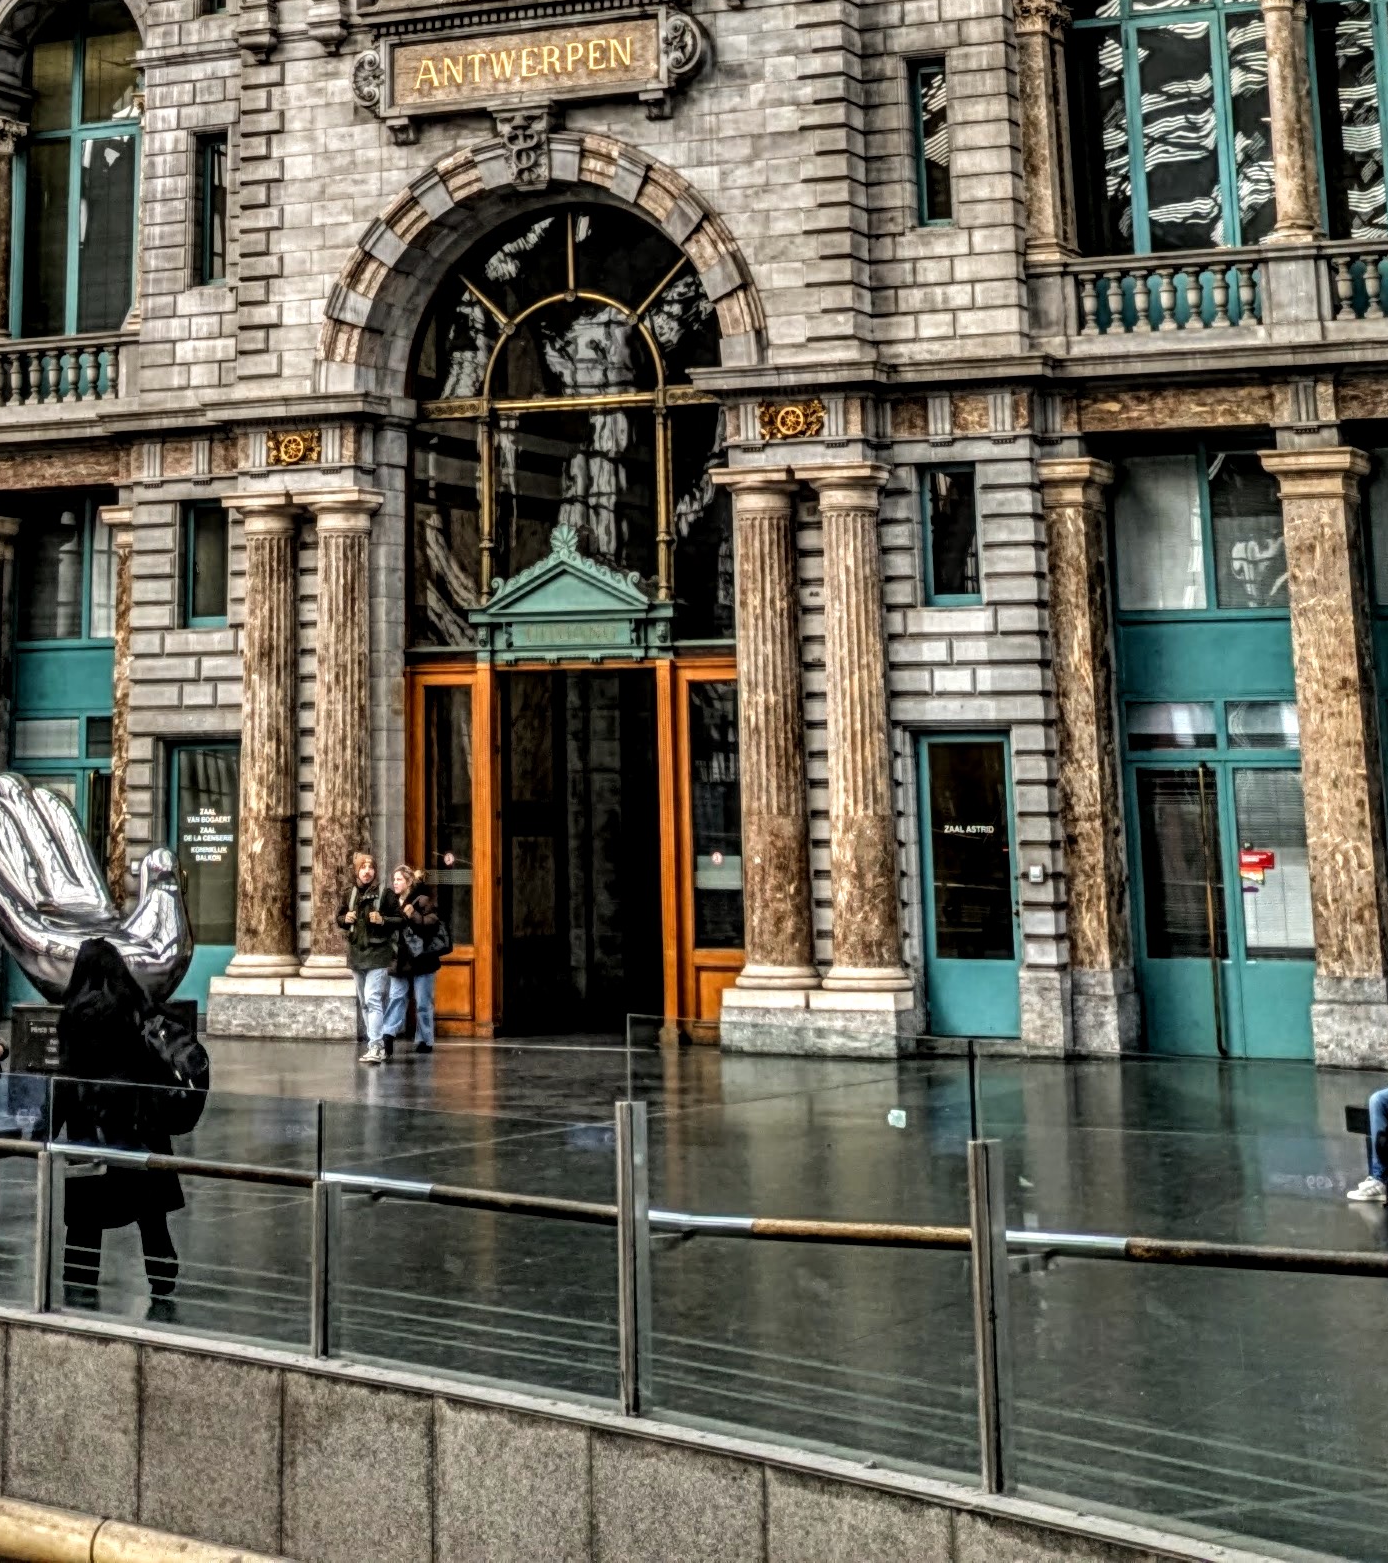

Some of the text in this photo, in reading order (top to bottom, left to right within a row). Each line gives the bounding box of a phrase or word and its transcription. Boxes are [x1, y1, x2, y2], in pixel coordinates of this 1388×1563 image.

[414, 36, 633, 89] ANTWERPEN
[944, 824, 994, 833] ZAAL ASTRID
